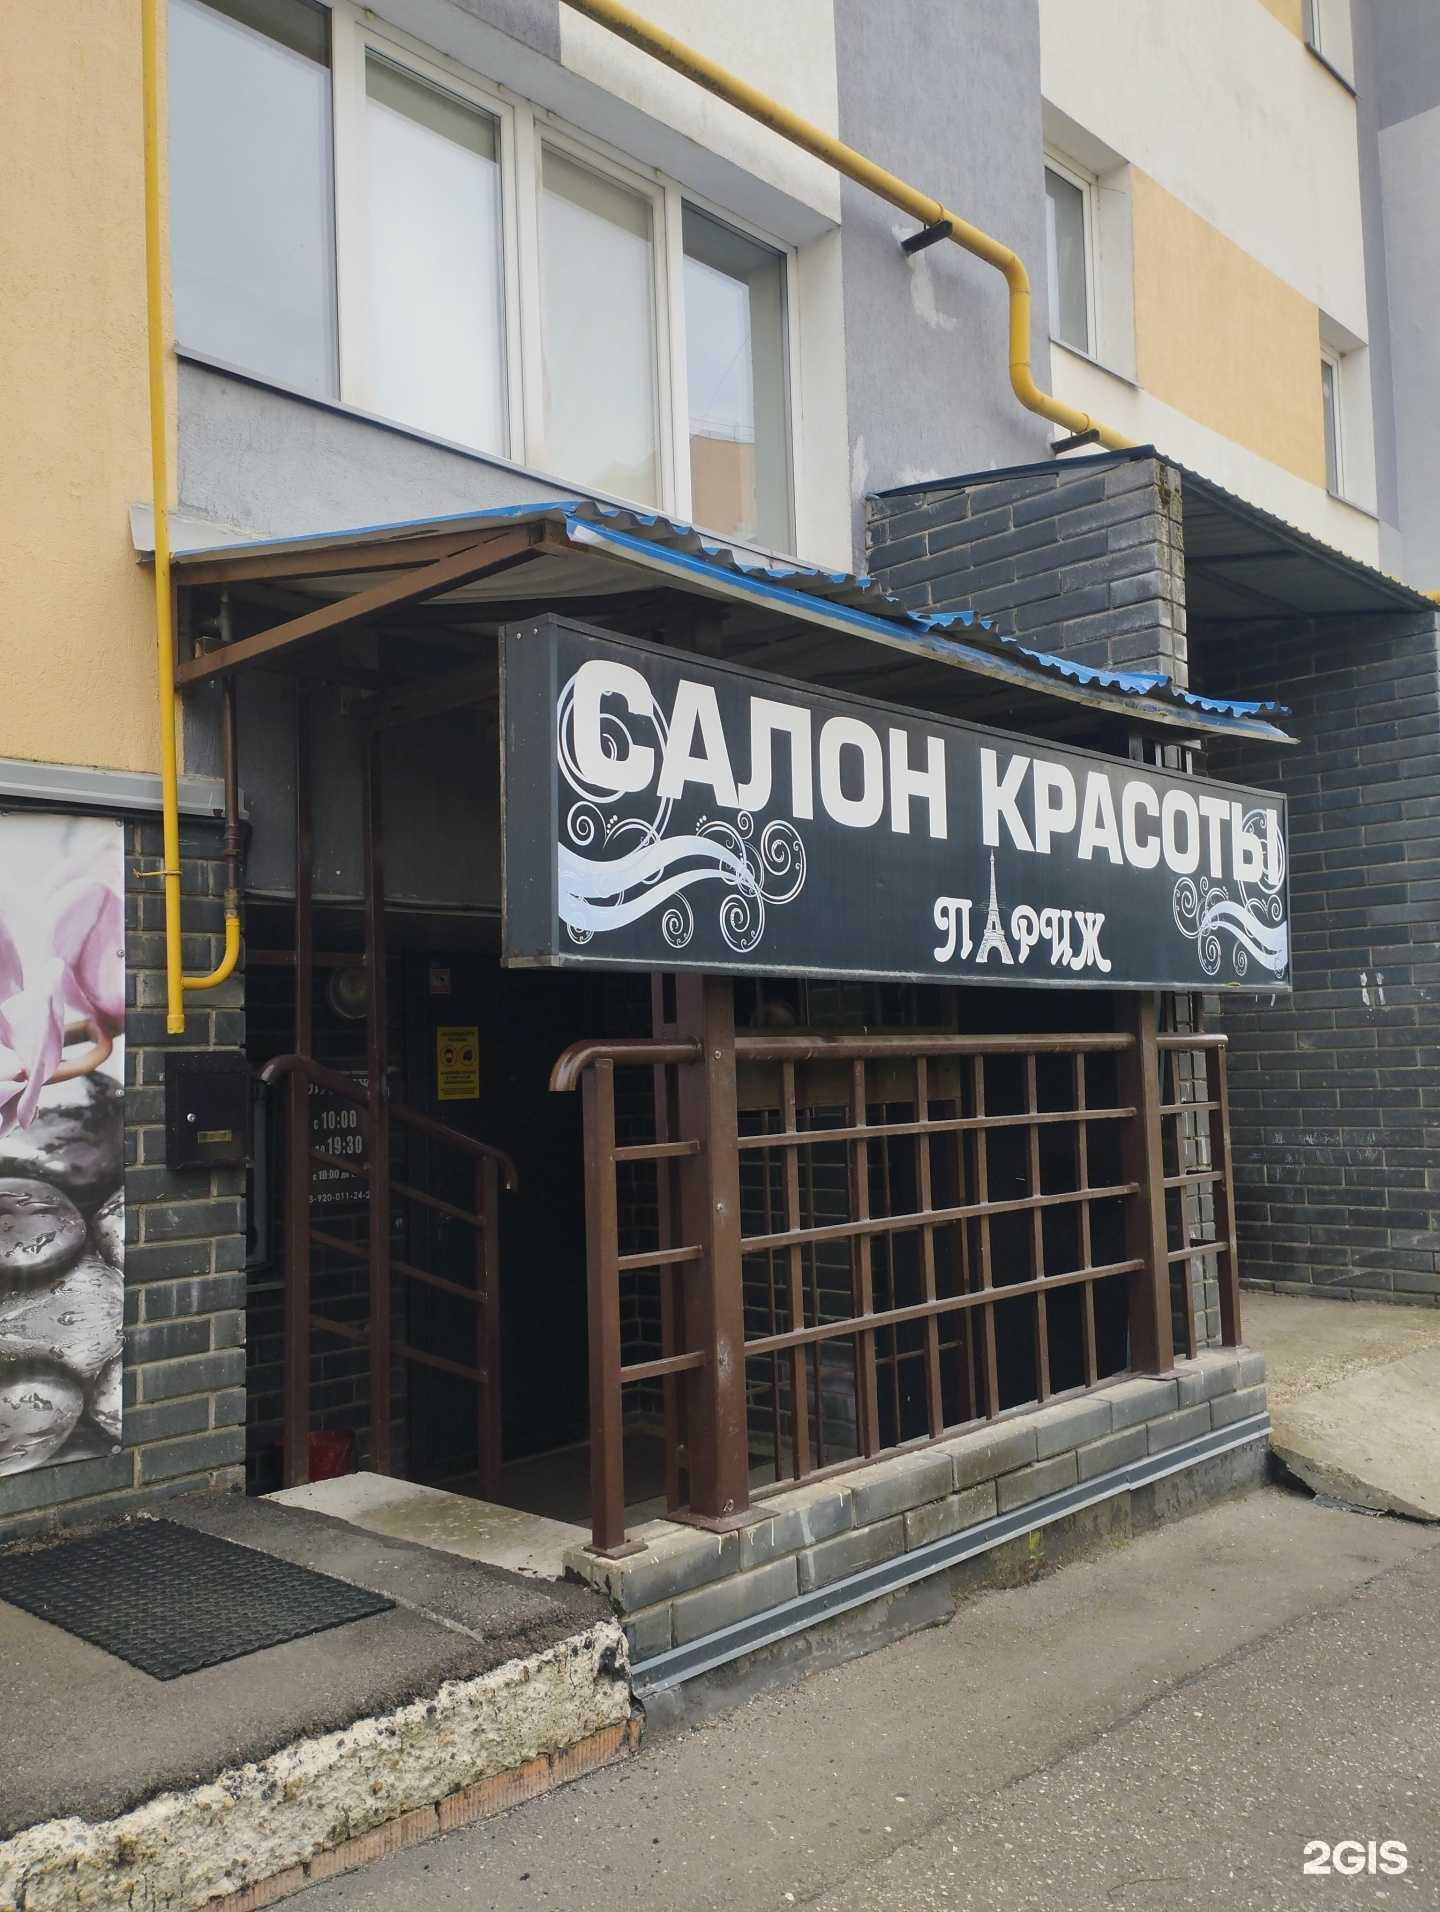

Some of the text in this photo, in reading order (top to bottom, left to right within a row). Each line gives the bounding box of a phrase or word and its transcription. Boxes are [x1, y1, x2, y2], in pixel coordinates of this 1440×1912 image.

[572, 660, 1281, 884] САЛОН КРАСОТЫ
[934, 868, 1112, 973] ПАРИЖ
[321, 1109, 357, 1129] 10:00
[327, 1135, 363, 1154] 19:30
